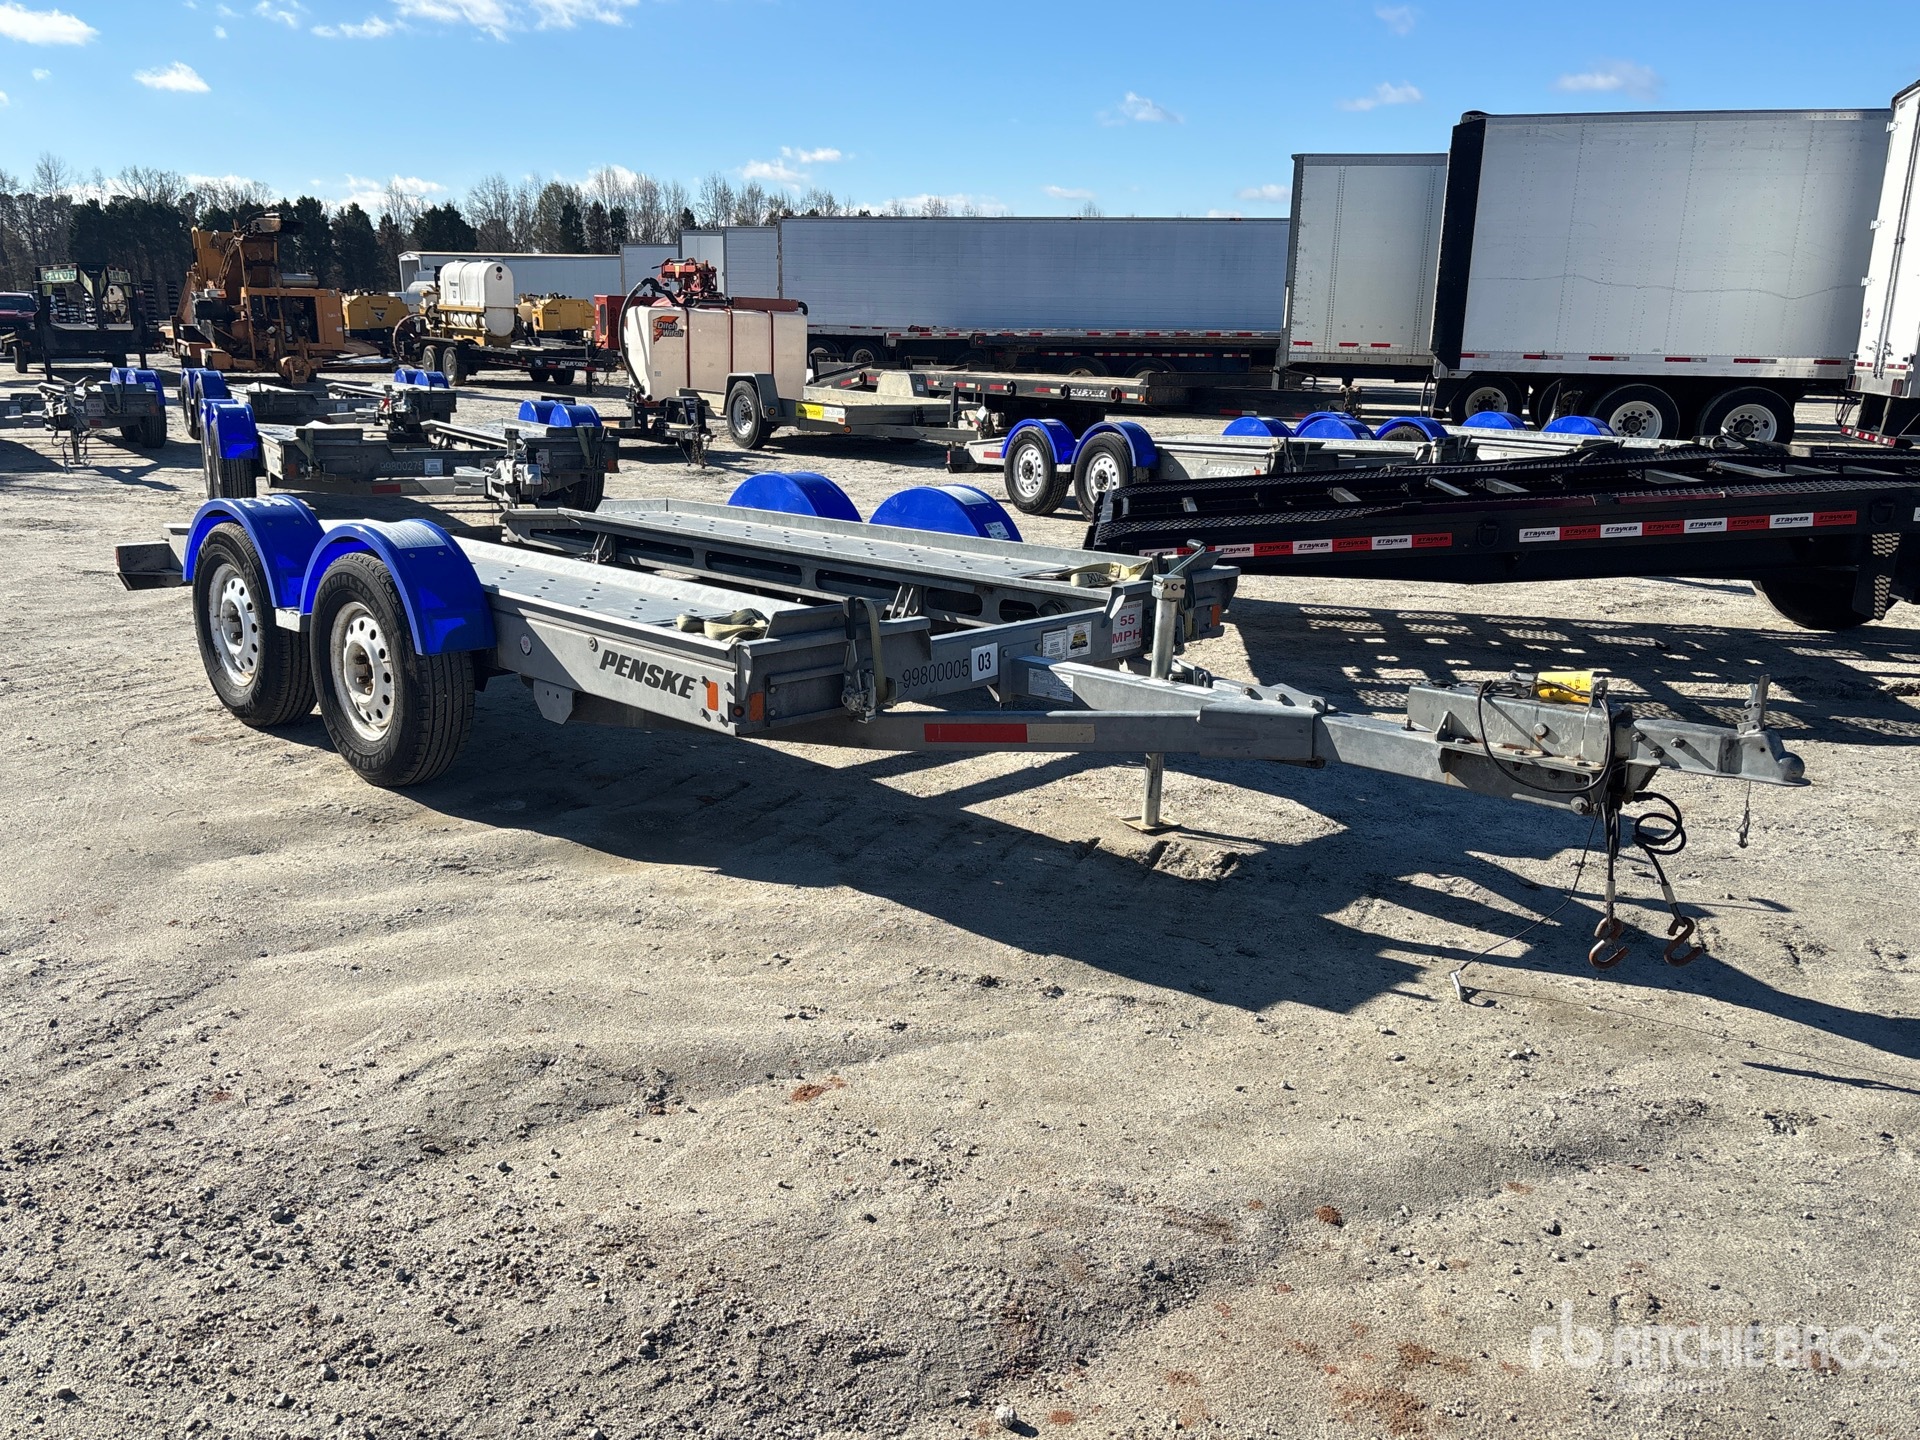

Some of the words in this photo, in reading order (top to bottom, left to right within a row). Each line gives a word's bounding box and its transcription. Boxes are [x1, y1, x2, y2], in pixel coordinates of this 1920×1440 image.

[43, 269, 76, 281] GATOR
[657, 321, 678, 330] Ditch
[662, 329, 684, 337] Witch
[380, 460, 424, 471] 99800275
[1523, 530, 1556, 539] STRYKER
[1604, 525, 1638, 535] STRYKER
[1688, 520, 1723, 530] STRYKER
[1774, 515, 1809, 524] STRYKER
[1297, 542, 1329, 551] STRYKER
[1376, 537, 1408, 546] STRYKER
[1120, 614, 1135, 627] 55
[1112, 628, 1142, 644] MPH
[977, 651, 991, 671] 03
[599, 649, 697, 699] PENSKE
[902, 658, 969, 689] 99800005
